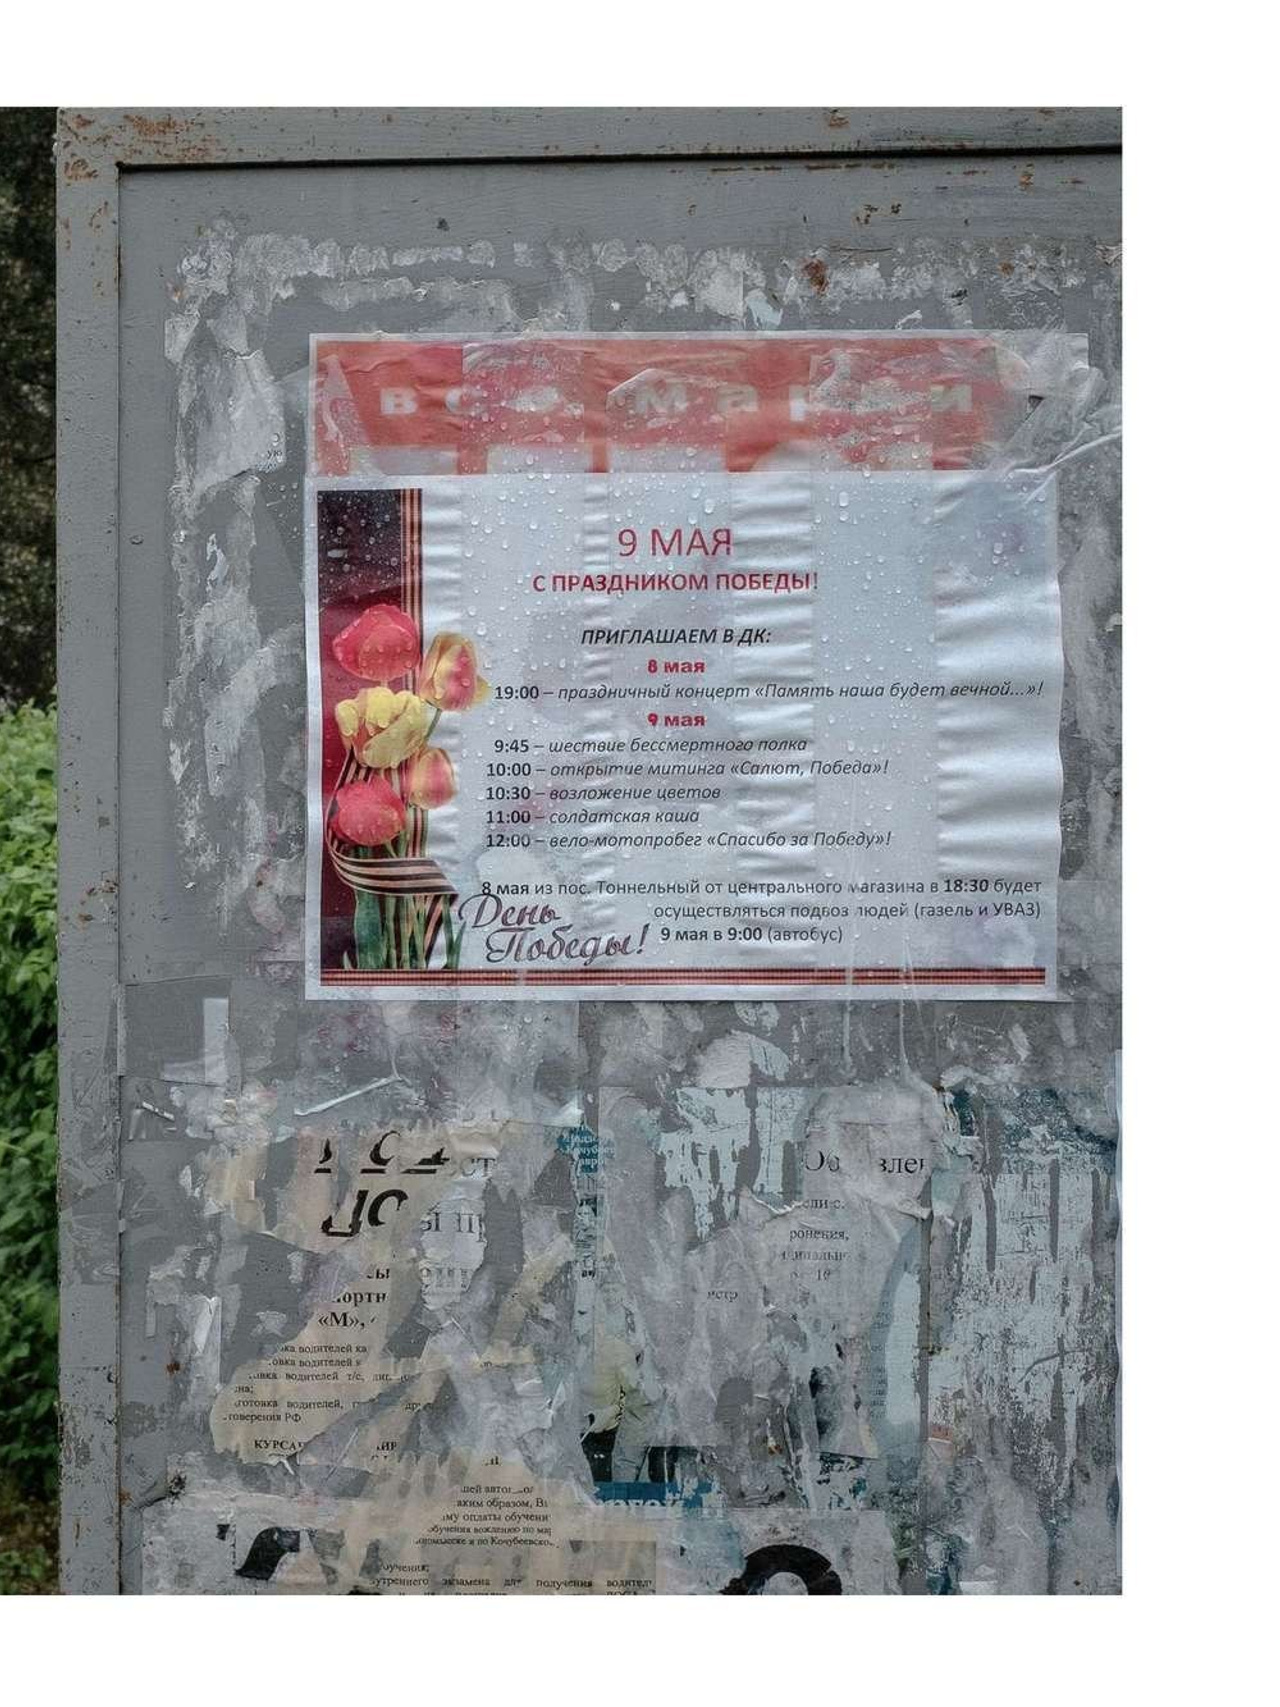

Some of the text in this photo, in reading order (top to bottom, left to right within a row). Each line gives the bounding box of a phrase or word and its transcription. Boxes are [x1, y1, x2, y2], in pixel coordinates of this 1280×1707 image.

[618, 528, 732, 557] 9 МАЯ
[532, 572, 819, 595] С ПРАЗДНИКОМ ПОБЕДЫ!
[580, 628, 772, 646] ПРИГЛАШАЕМ В ДК:
[647, 659, 706, 674] 8 мая
[495, 686, 540, 700] 19:00
[557, 684, 671, 702] праздничный
[675, 687, 750, 701] концерт
[754, 684, 834, 698] «Память
[839, 685, 885, 698] наша
[889, 682, 946, 700] будет
[647, 712, 706, 727] 9 мая
[494, 739, 530, 753] 9:45
[549, 742, 627, 753] шествие
[630, 738, 754, 754] бессмертного
[757, 740, 808, 751] полка
[486, 763, 532, 777] 10:00
[550, 764, 643, 779] открытие
[647, 764, 725, 776] митинга
[730, 761, 805, 777] «Салют,
[810, 760, 890, 775] Победа»!
[486, 787, 531, 800] 10:30
[549, 788, 652, 800] возложение
[657, 787, 722, 802] цветов
[486, 810, 531, 824] 11:00
[549, 810, 651, 823] солдатская
[655, 811, 700, 823] каша
[486, 834, 531, 848] 12:00
[549, 833, 702, 849] вело-мотопробег
[707, 832, 786, 847] «Спасибо
[790, 835, 809, 846] за
[813, 831, 893, 848] Победу»!
[482, 881, 492, 896] 8
[496, 884, 530, 896] мая
[534, 884, 554, 895] из
[558, 883, 593, 895] пос.
[597, 879, 701, 894] Тоннельный
[705, 883, 724, 894] от
[728, 881, 842, 897] центрального
[930, 881, 940, 893] в
[944, 878, 990, 893] 18:30
[993, 878, 1043, 897] будет
[458, 892, 562, 930] День
[654, 903, 785, 920] осуществляться
[790, 905, 850, 920] подвоз
[913, 902, 974, 920] (газель
[978, 904, 989, 916] и
[993, 901, 1041, 919] УВАЗ)
[485, 922, 651, 966] Победы!
[661, 927, 844, 943] 9 мая в 9:00 (автобус)
[299, 1343, 353, 1354] водителей
[299, 1358, 352, 1368] водителей
[285, 1371, 339, 1382] водителей
